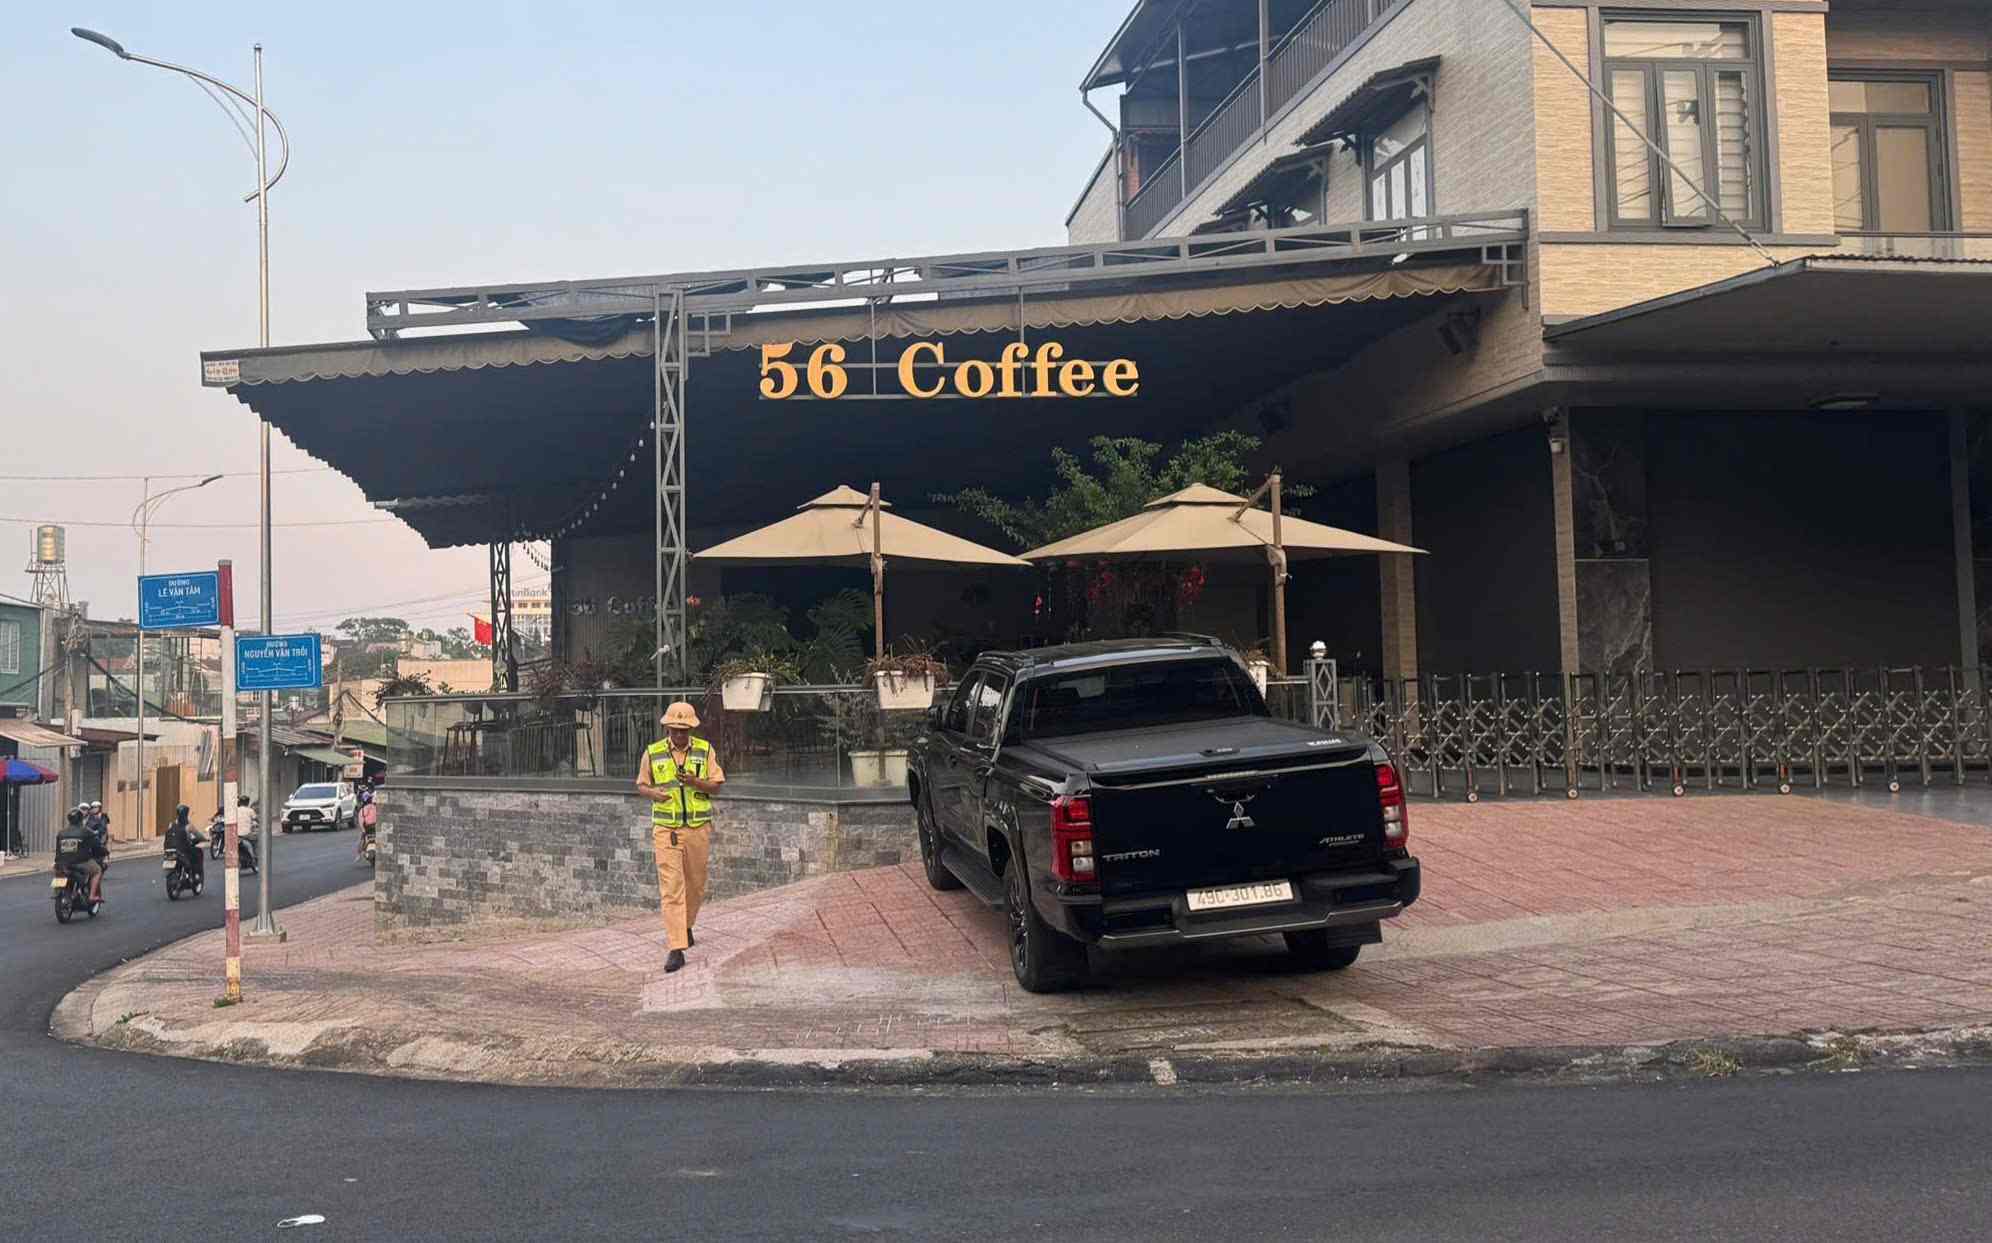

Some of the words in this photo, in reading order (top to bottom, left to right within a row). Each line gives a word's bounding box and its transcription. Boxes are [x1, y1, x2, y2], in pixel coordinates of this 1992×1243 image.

[759, 343, 848, 399] 56
[898, 341, 1139, 399] Coffee
[1102, 848, 1160, 862] TRITON
